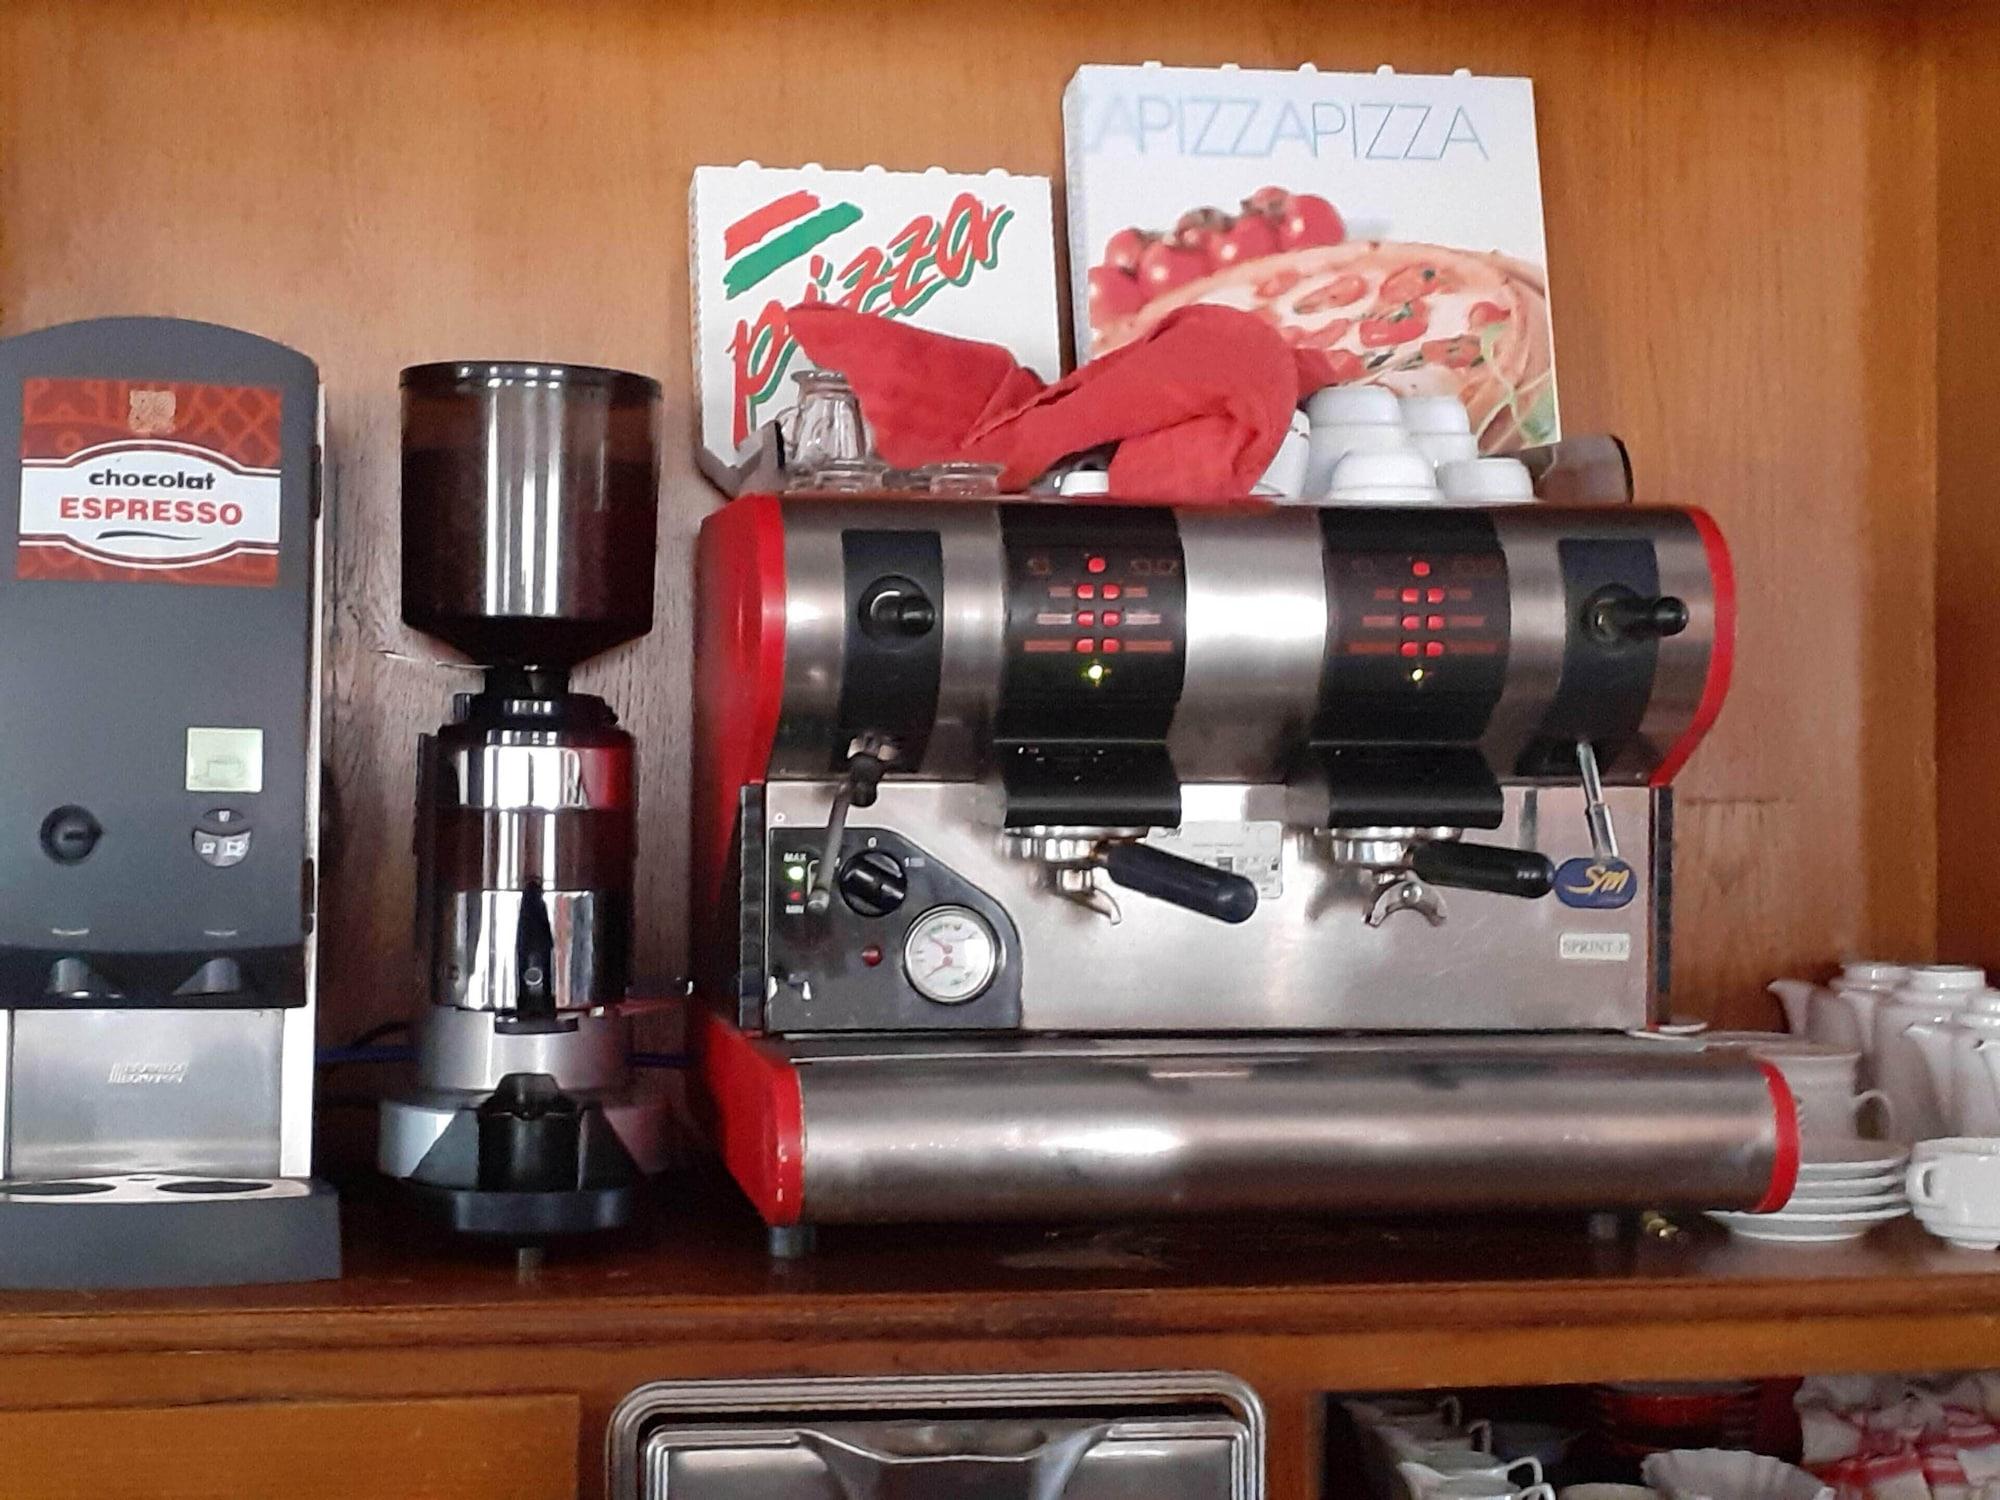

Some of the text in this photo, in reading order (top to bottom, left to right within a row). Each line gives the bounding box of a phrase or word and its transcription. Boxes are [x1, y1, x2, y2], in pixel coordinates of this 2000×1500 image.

[725, 193, 1015, 451] pizza
[89, 469, 216, 491] chocolat
[60, 497, 243, 526] ESPRESSO
[783, 852, 807, 863] MAX
